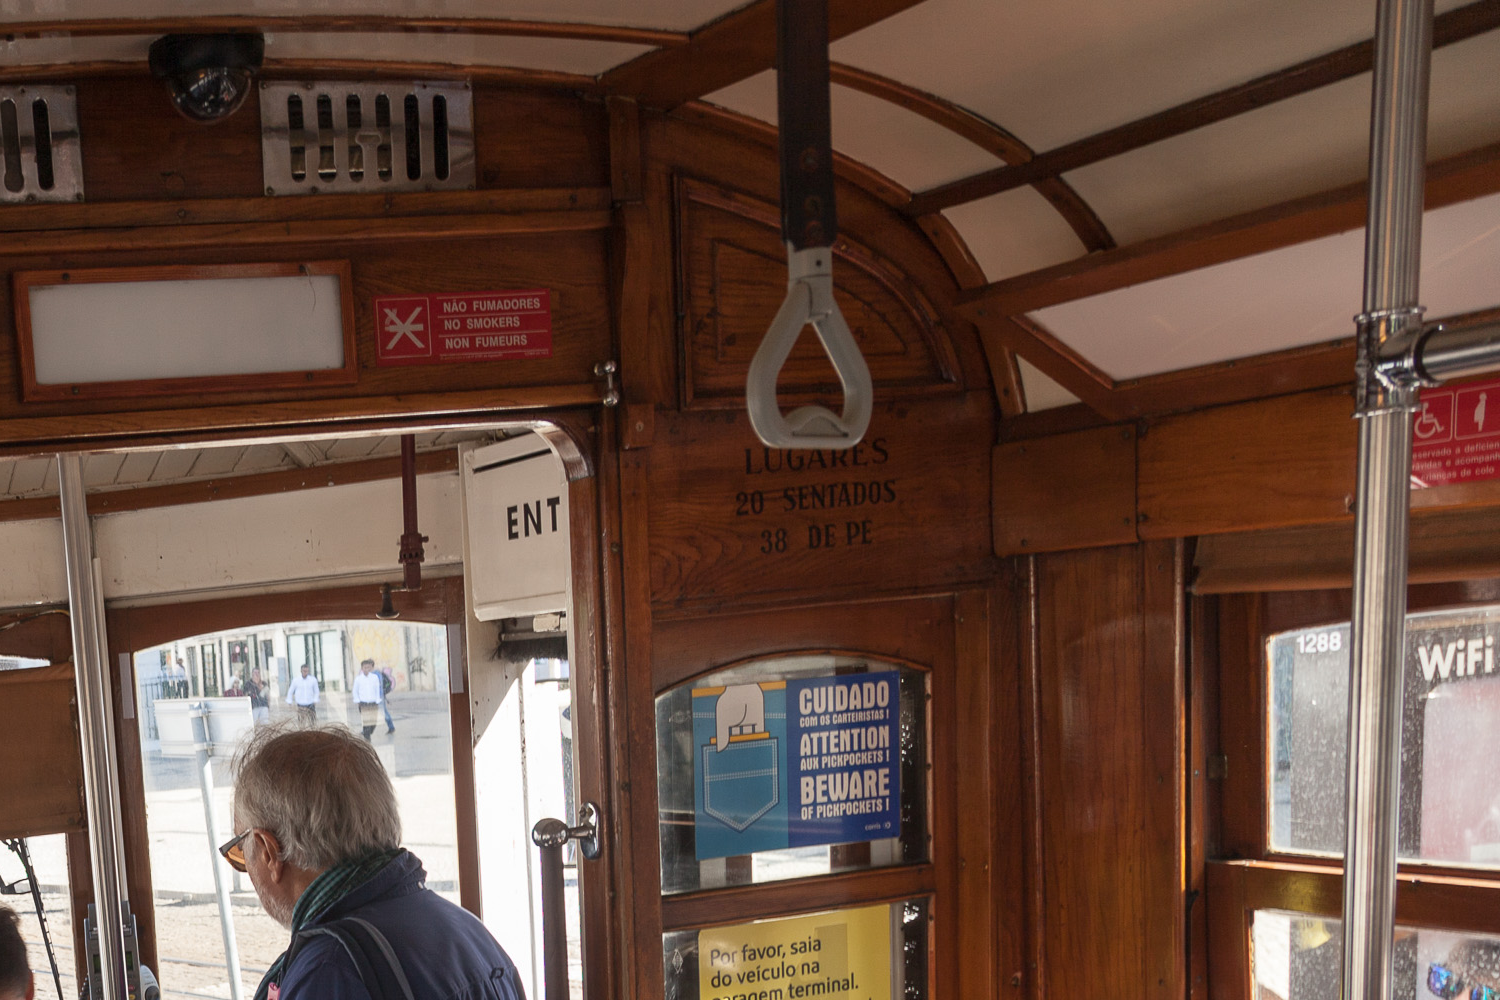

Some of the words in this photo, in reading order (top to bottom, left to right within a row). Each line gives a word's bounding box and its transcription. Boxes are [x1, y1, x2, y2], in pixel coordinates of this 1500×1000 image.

[473, 298, 540, 311] FUMADORES
[444, 319, 460, 330] NO
[467, 316, 520, 329] SMOKERS
[445, 337, 470, 349] NON
[476, 334, 528, 348] FUMEURS
[745, 438, 888, 474] LUGARES
[1412, 446, 1452, 459] eservado
[1460, 468, 1471, 477] de
[1475, 465, 1494, 476] colo
[736, 490, 764, 516] 20
[783, 480, 896, 512] SENTADOS
[507, 496, 560, 540] ENT
[761, 528, 788, 554] 38
[808, 523, 837, 550] DE
[1296, 632, 1342, 654] 1288
[1418, 635, 1494, 681] WiFi
[799, 680, 890, 715] CUIDADO
[800, 716, 818, 728] COM
[820, 714, 830, 726] OS
[832, 709, 884, 725] CARTEIRISTAS
[800, 725, 890, 756] ATTENTION
[800, 757, 819, 771] AUX
[822, 750, 883, 769] PICKPOCKETS
[800, 768, 890, 805] BEWARE
[801, 806, 814, 820] OF
[816, 798, 883, 819] PICKPOCKETS
[710, 949, 738, 966] Por
[742, 944, 786, 962] favor,
[790, 936, 822, 955] saia
[711, 971, 732, 988] do
[737, 961, 796, 984] veículo
[801, 960, 820, 975] na
[788, 972, 859, 999] terminal.
